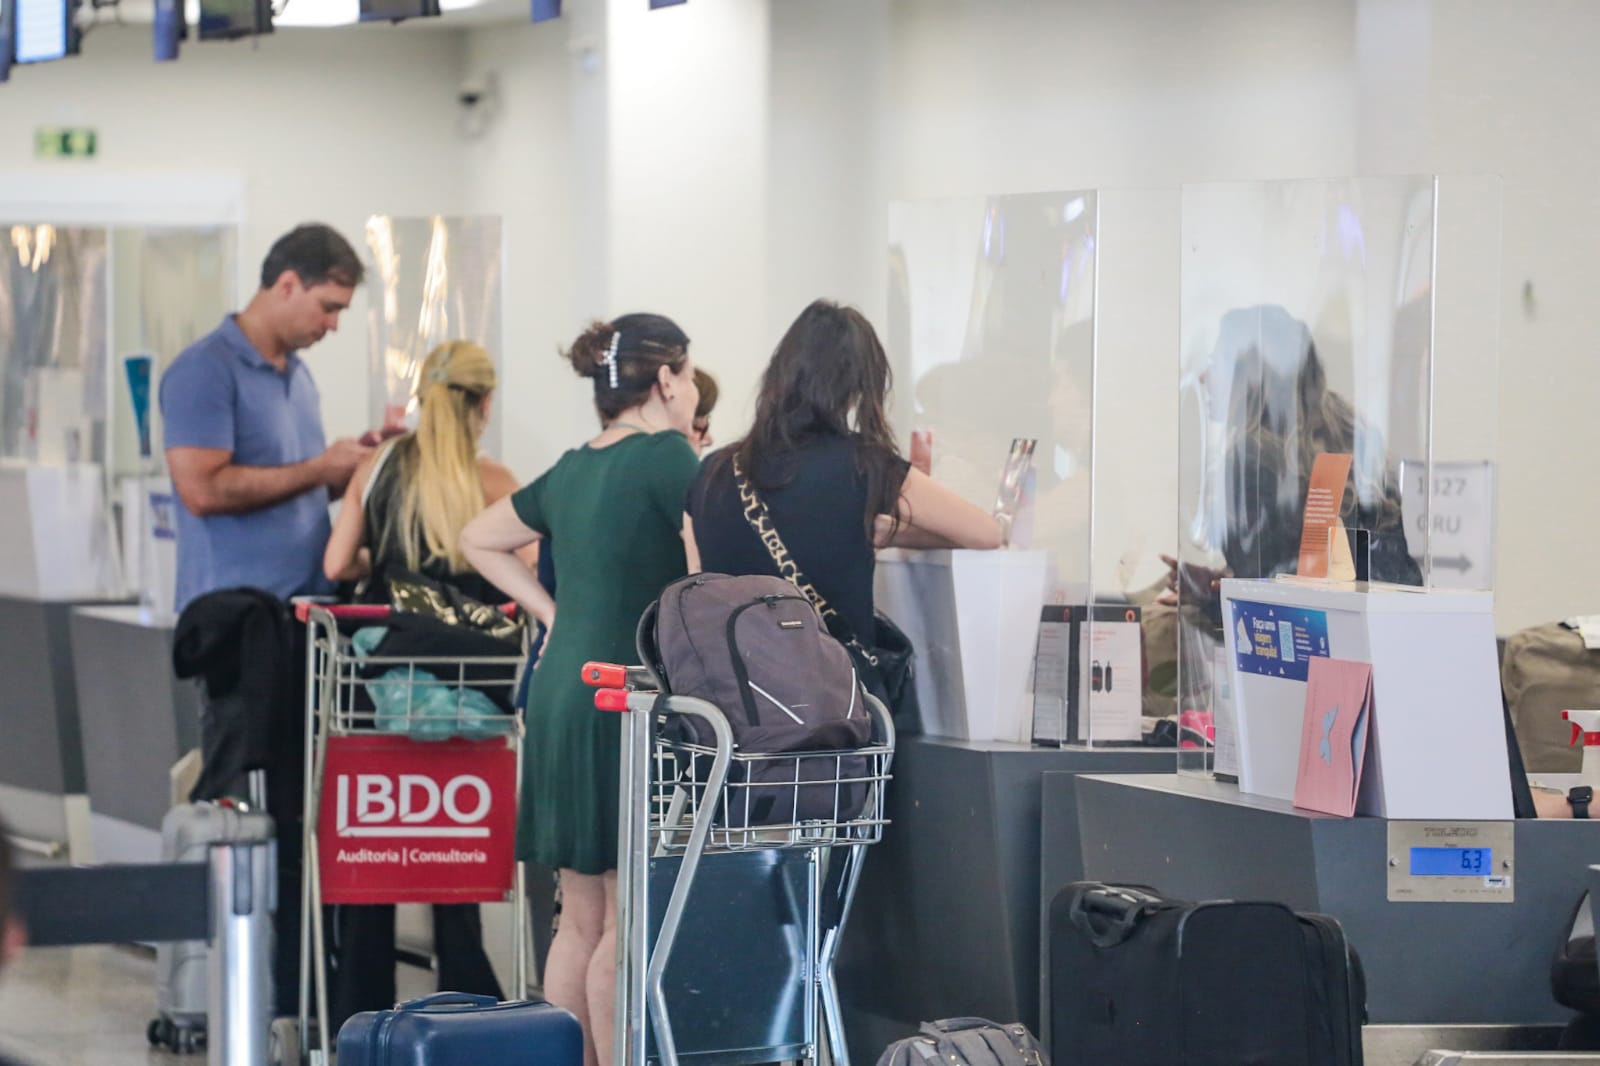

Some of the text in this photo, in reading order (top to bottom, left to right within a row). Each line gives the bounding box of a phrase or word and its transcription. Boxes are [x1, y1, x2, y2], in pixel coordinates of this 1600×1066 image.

[356, 774, 492, 823] BDO
[336, 848, 487, 864] Auditoria Consultoria
